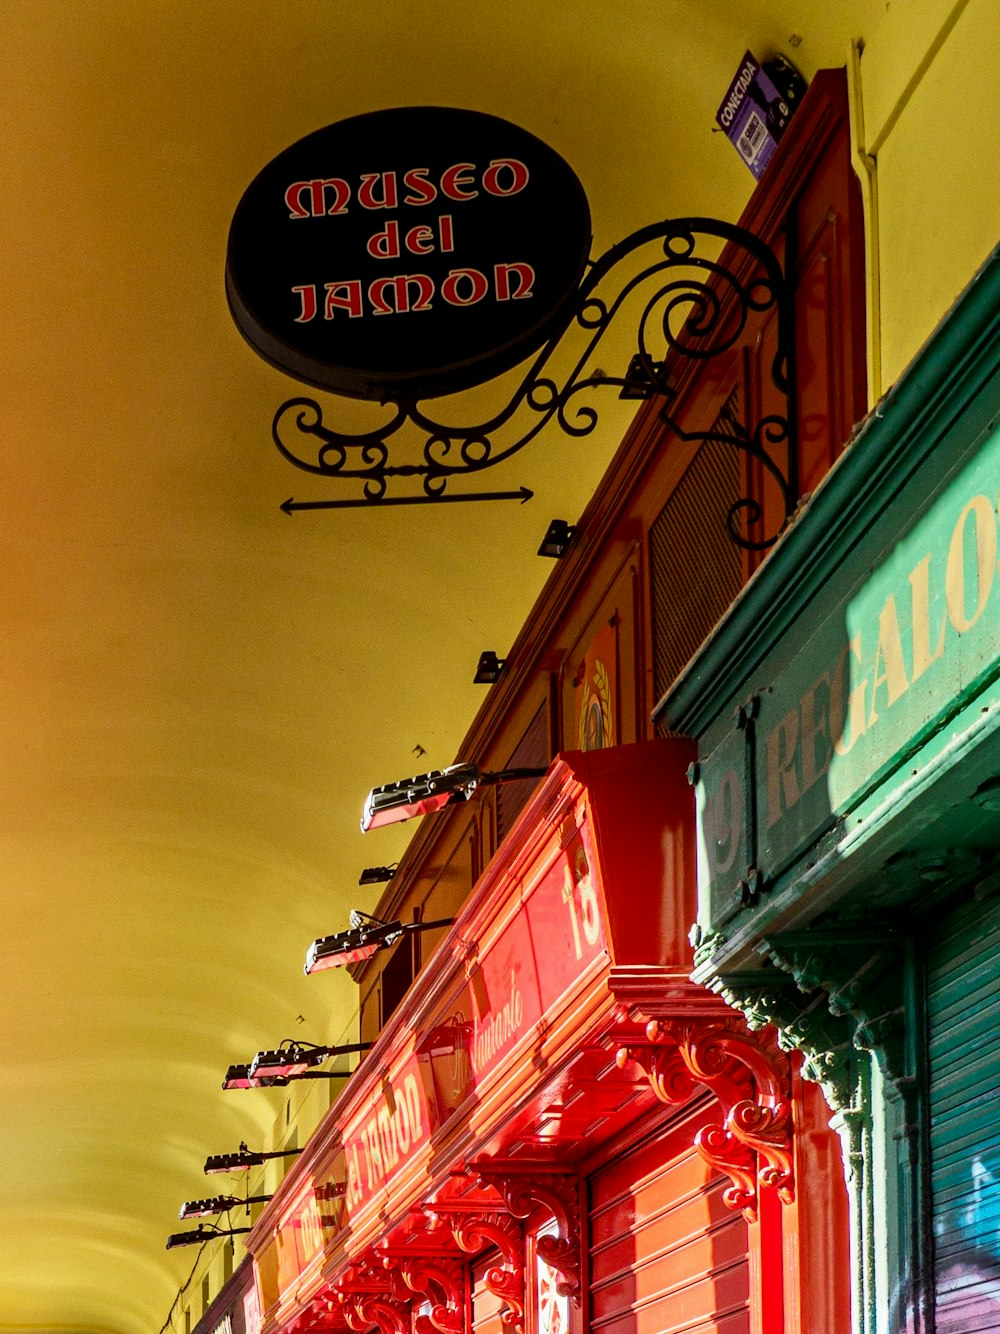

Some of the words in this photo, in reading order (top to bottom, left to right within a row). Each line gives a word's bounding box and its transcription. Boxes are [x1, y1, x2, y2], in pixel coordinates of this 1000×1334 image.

[720, 61, 757, 127] CONECTADA
[284, 158, 530, 219] MUSEO
[366, 214, 455, 259] del
[291, 262, 536, 323] JAMON
[766, 487, 1000, 829] REGALO
[561, 844, 600, 960] 18
